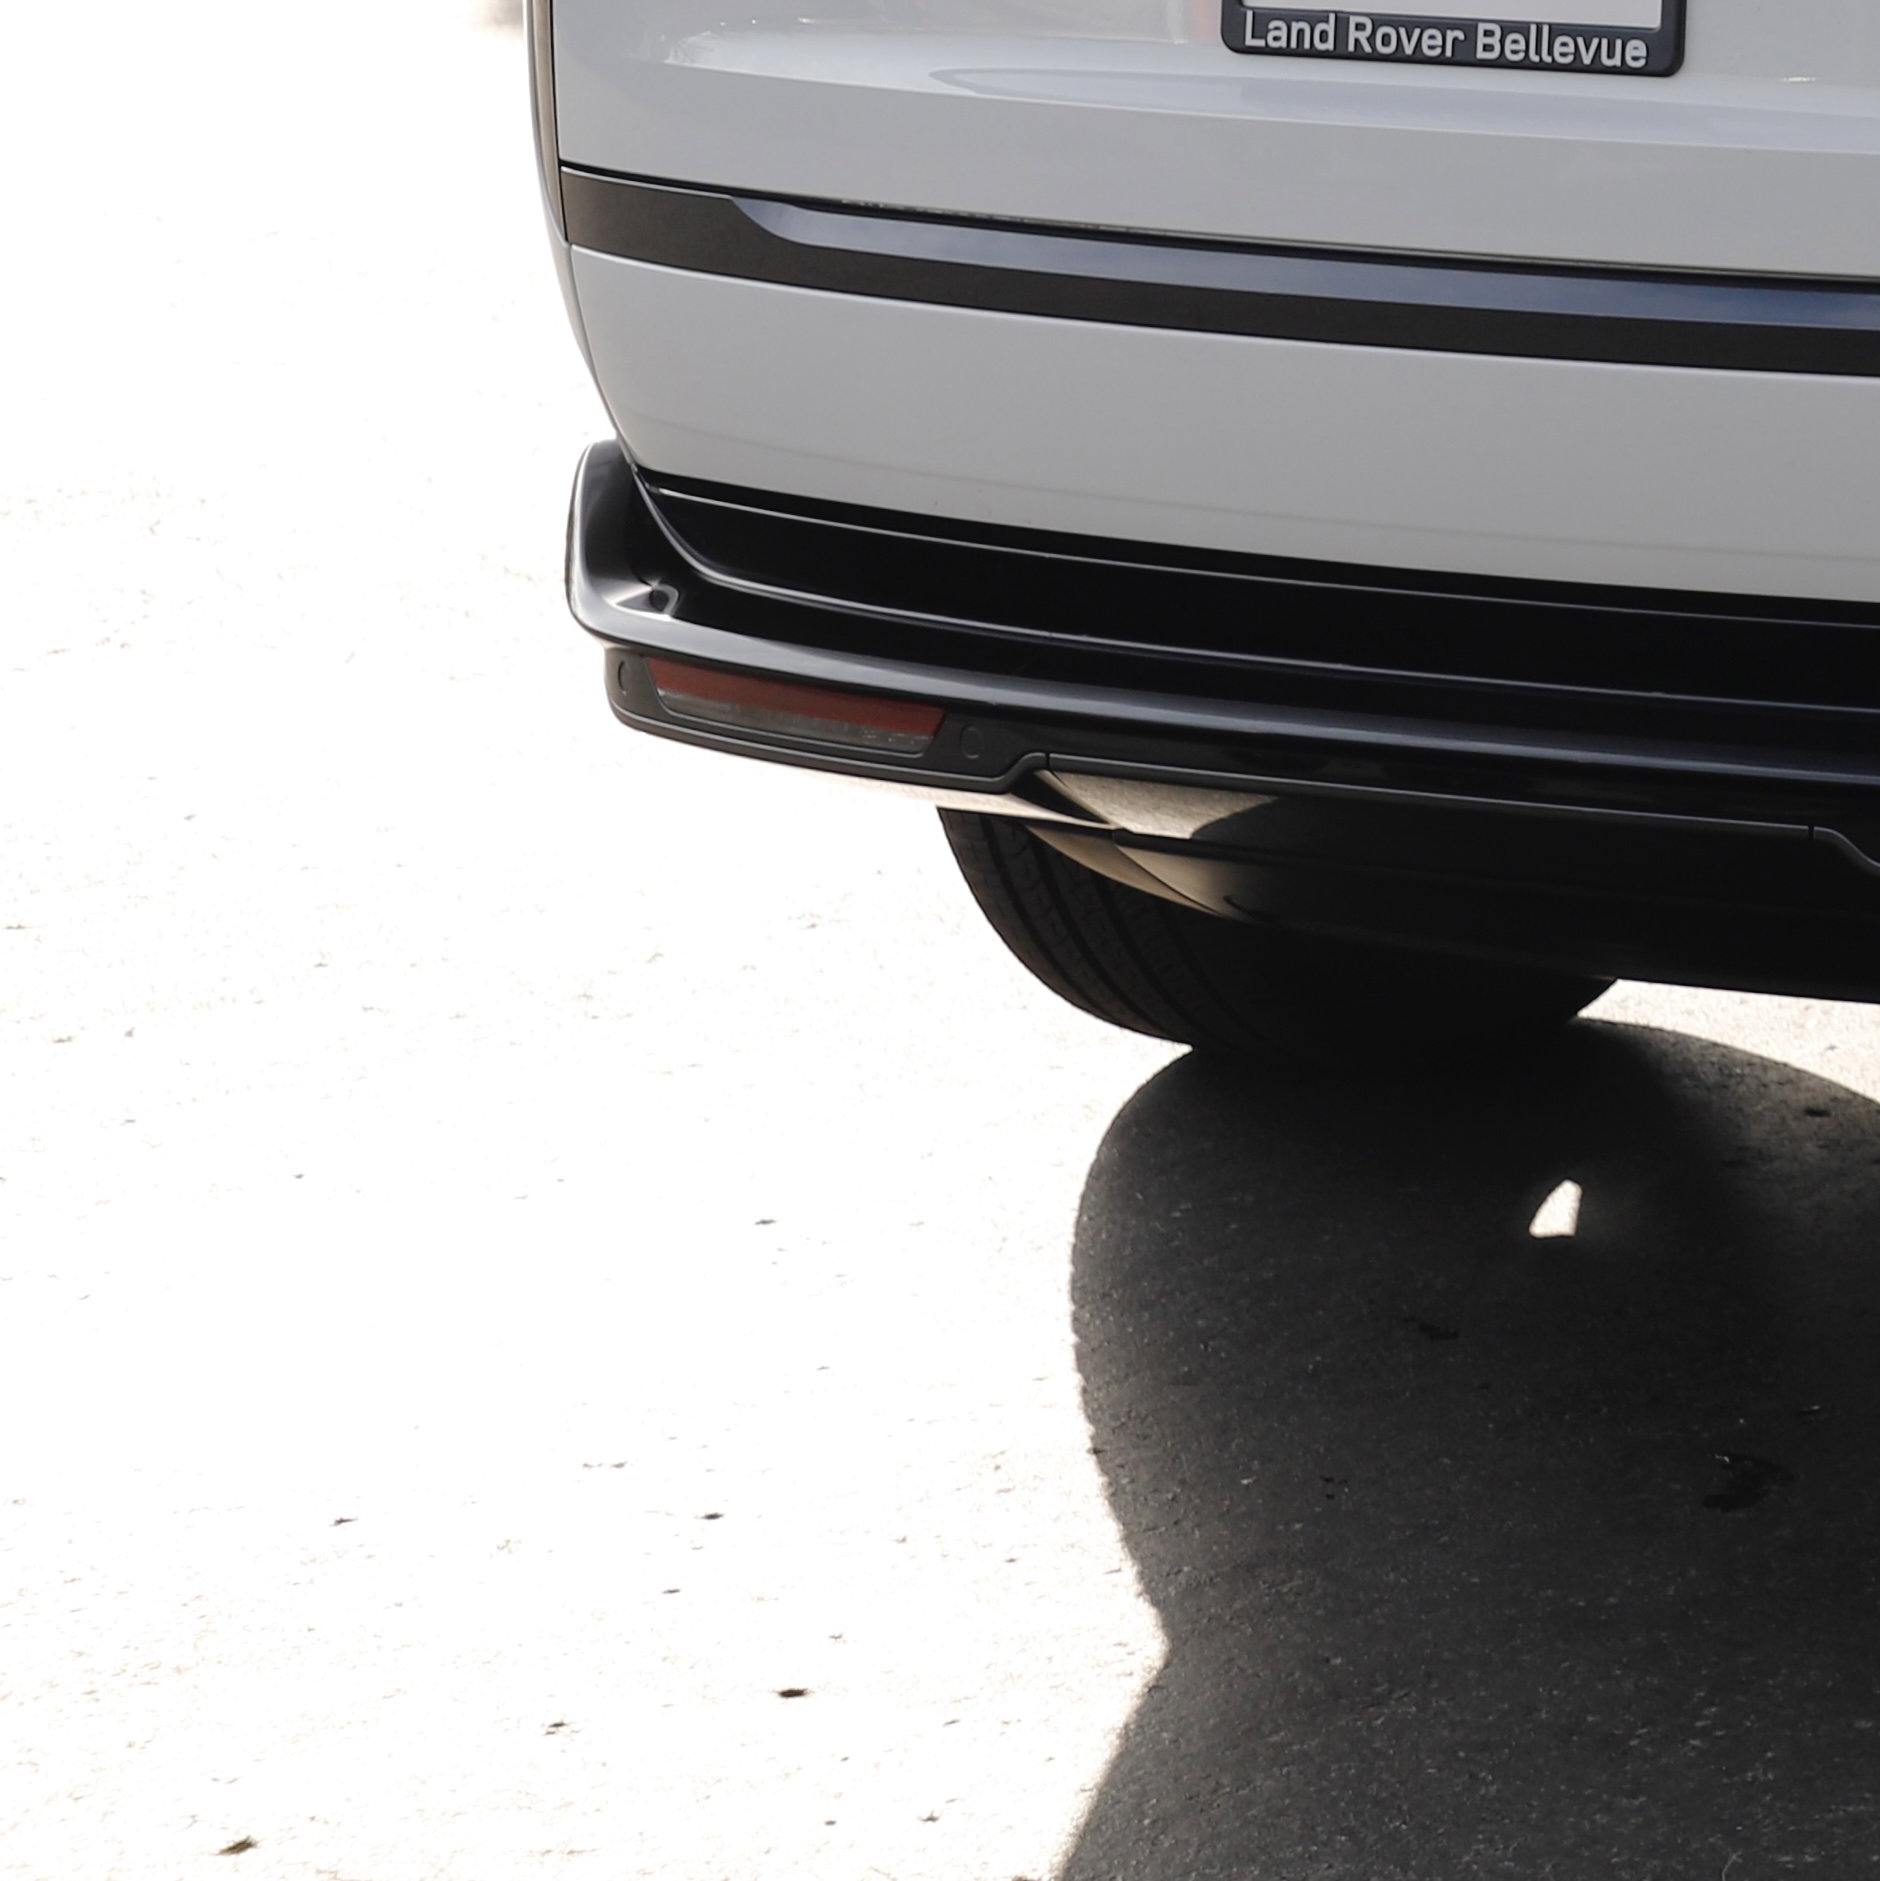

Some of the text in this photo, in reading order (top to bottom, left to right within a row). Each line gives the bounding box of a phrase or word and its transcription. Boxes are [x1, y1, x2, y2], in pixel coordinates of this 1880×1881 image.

[1244, 9, 1648, 69] Land Rover Bellevue
